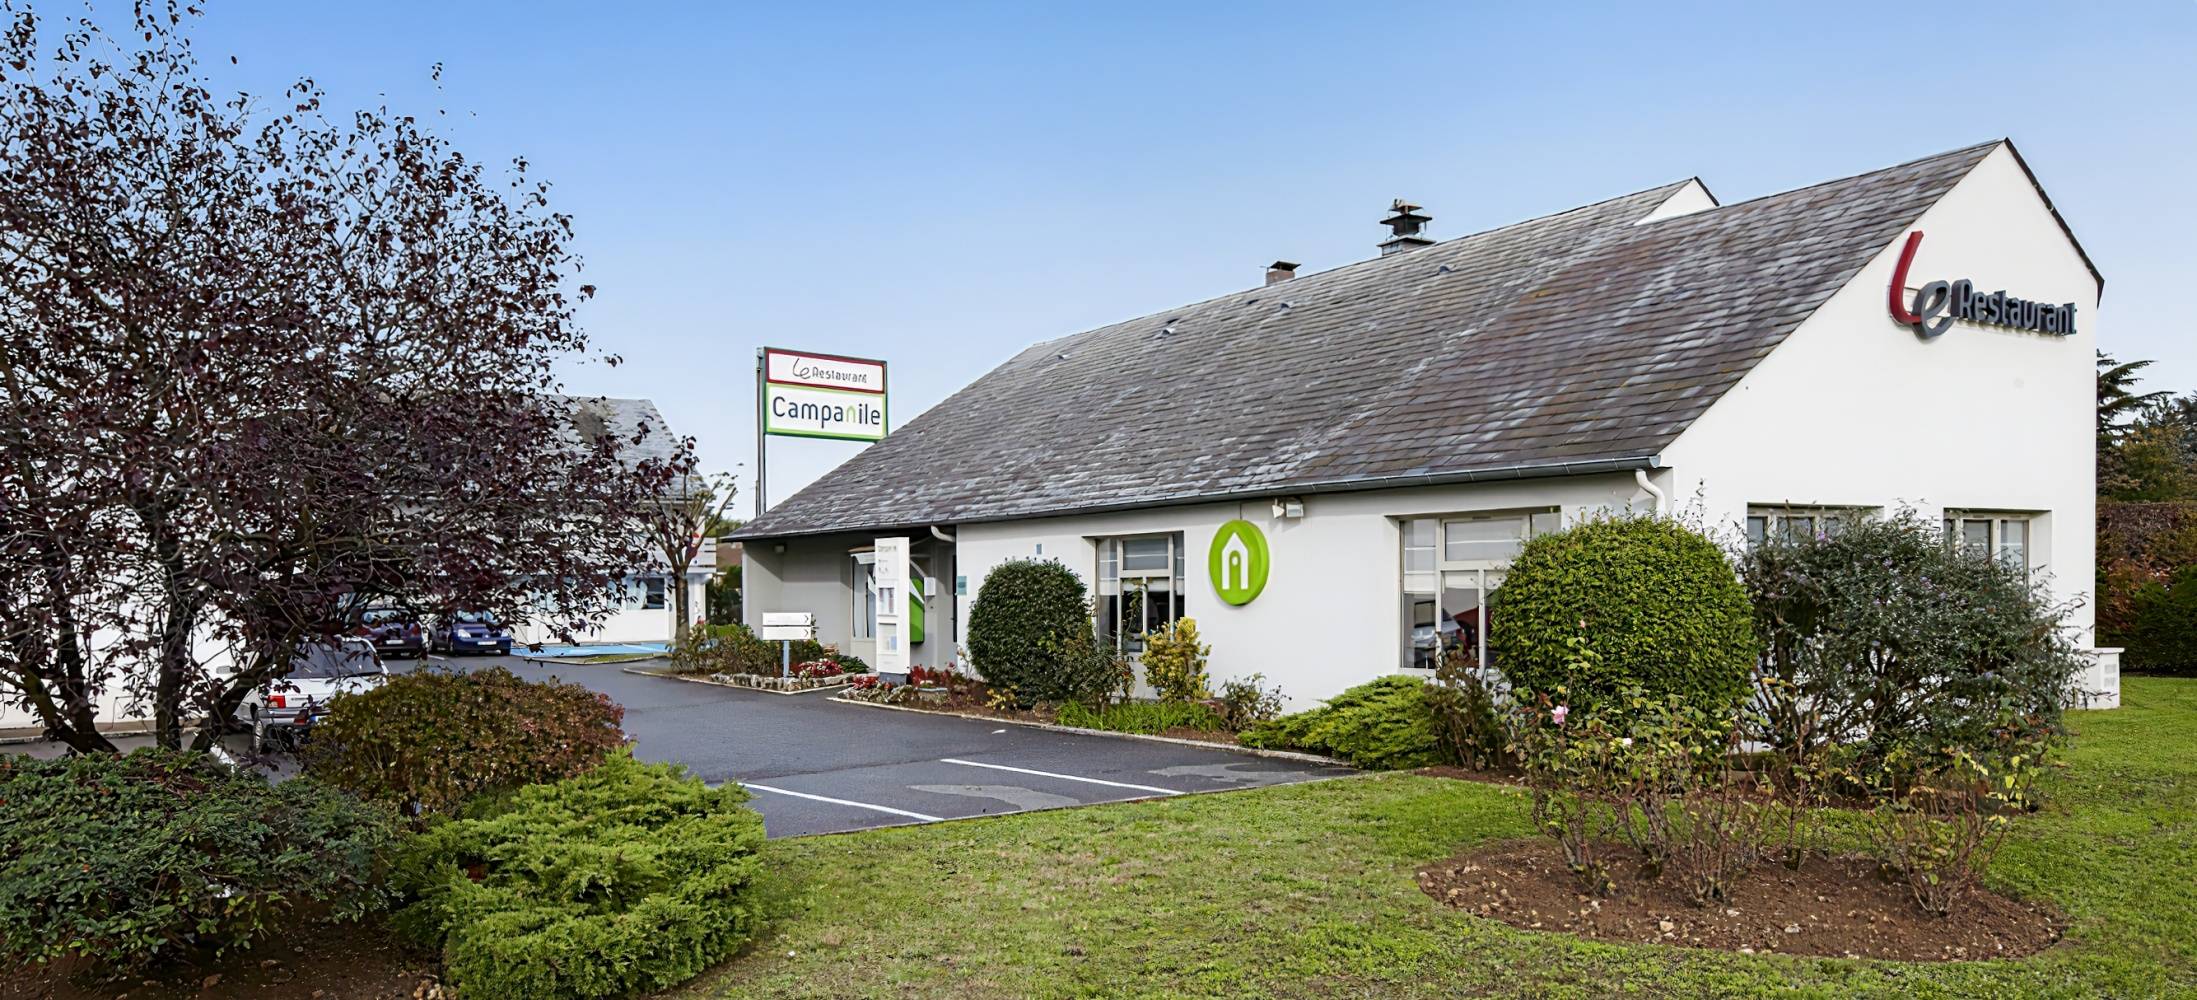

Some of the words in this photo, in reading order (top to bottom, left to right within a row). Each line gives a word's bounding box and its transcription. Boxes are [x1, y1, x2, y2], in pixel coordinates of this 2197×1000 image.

[1889, 230, 1954, 337] Le
[1951, 278, 2077, 336] Restaurant
[792, 357, 811, 379] Le
[812, 366, 867, 384] Restaurant
[772, 396, 881, 429] Campanile
